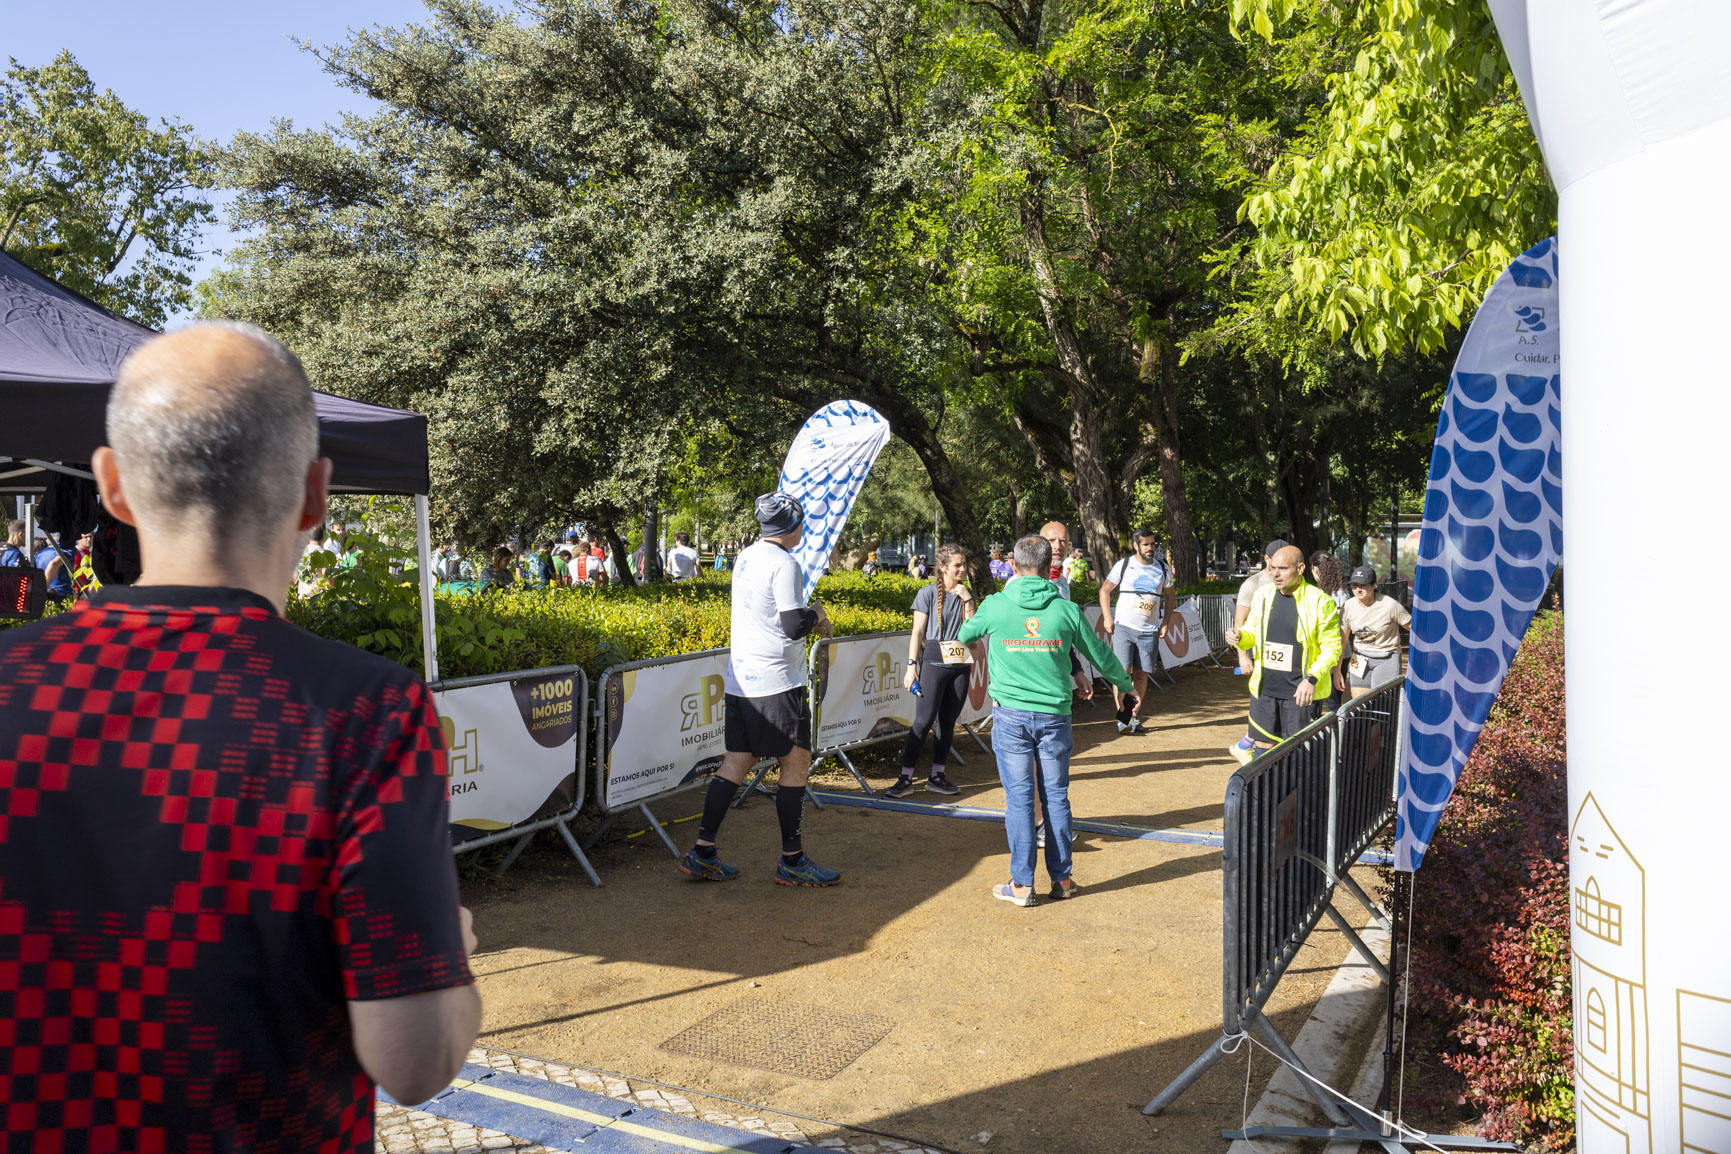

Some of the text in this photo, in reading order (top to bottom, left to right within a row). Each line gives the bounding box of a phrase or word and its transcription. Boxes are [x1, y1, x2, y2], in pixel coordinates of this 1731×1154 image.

[1514, 352, 1560, 364] Cuidar. P
[1002, 639, 1063, 647] PROCURAME
[948, 647, 965, 656] 207
[1265, 650, 1284, 662] 152
[530, 679, 573, 701] +1000
[864, 693, 900, 706] IMOBILIÁRIA
[532, 700, 573, 719] IMÓVEIS
[531, 715, 572, 731] ANGARIADOS
[681, 725, 726, 747] IMOBILIÁR
[611, 771, 640, 785] ESTAMOS
[640, 768, 656, 778] AQUI
[656, 764, 669, 774] POR
[669, 762, 675, 770] SI
